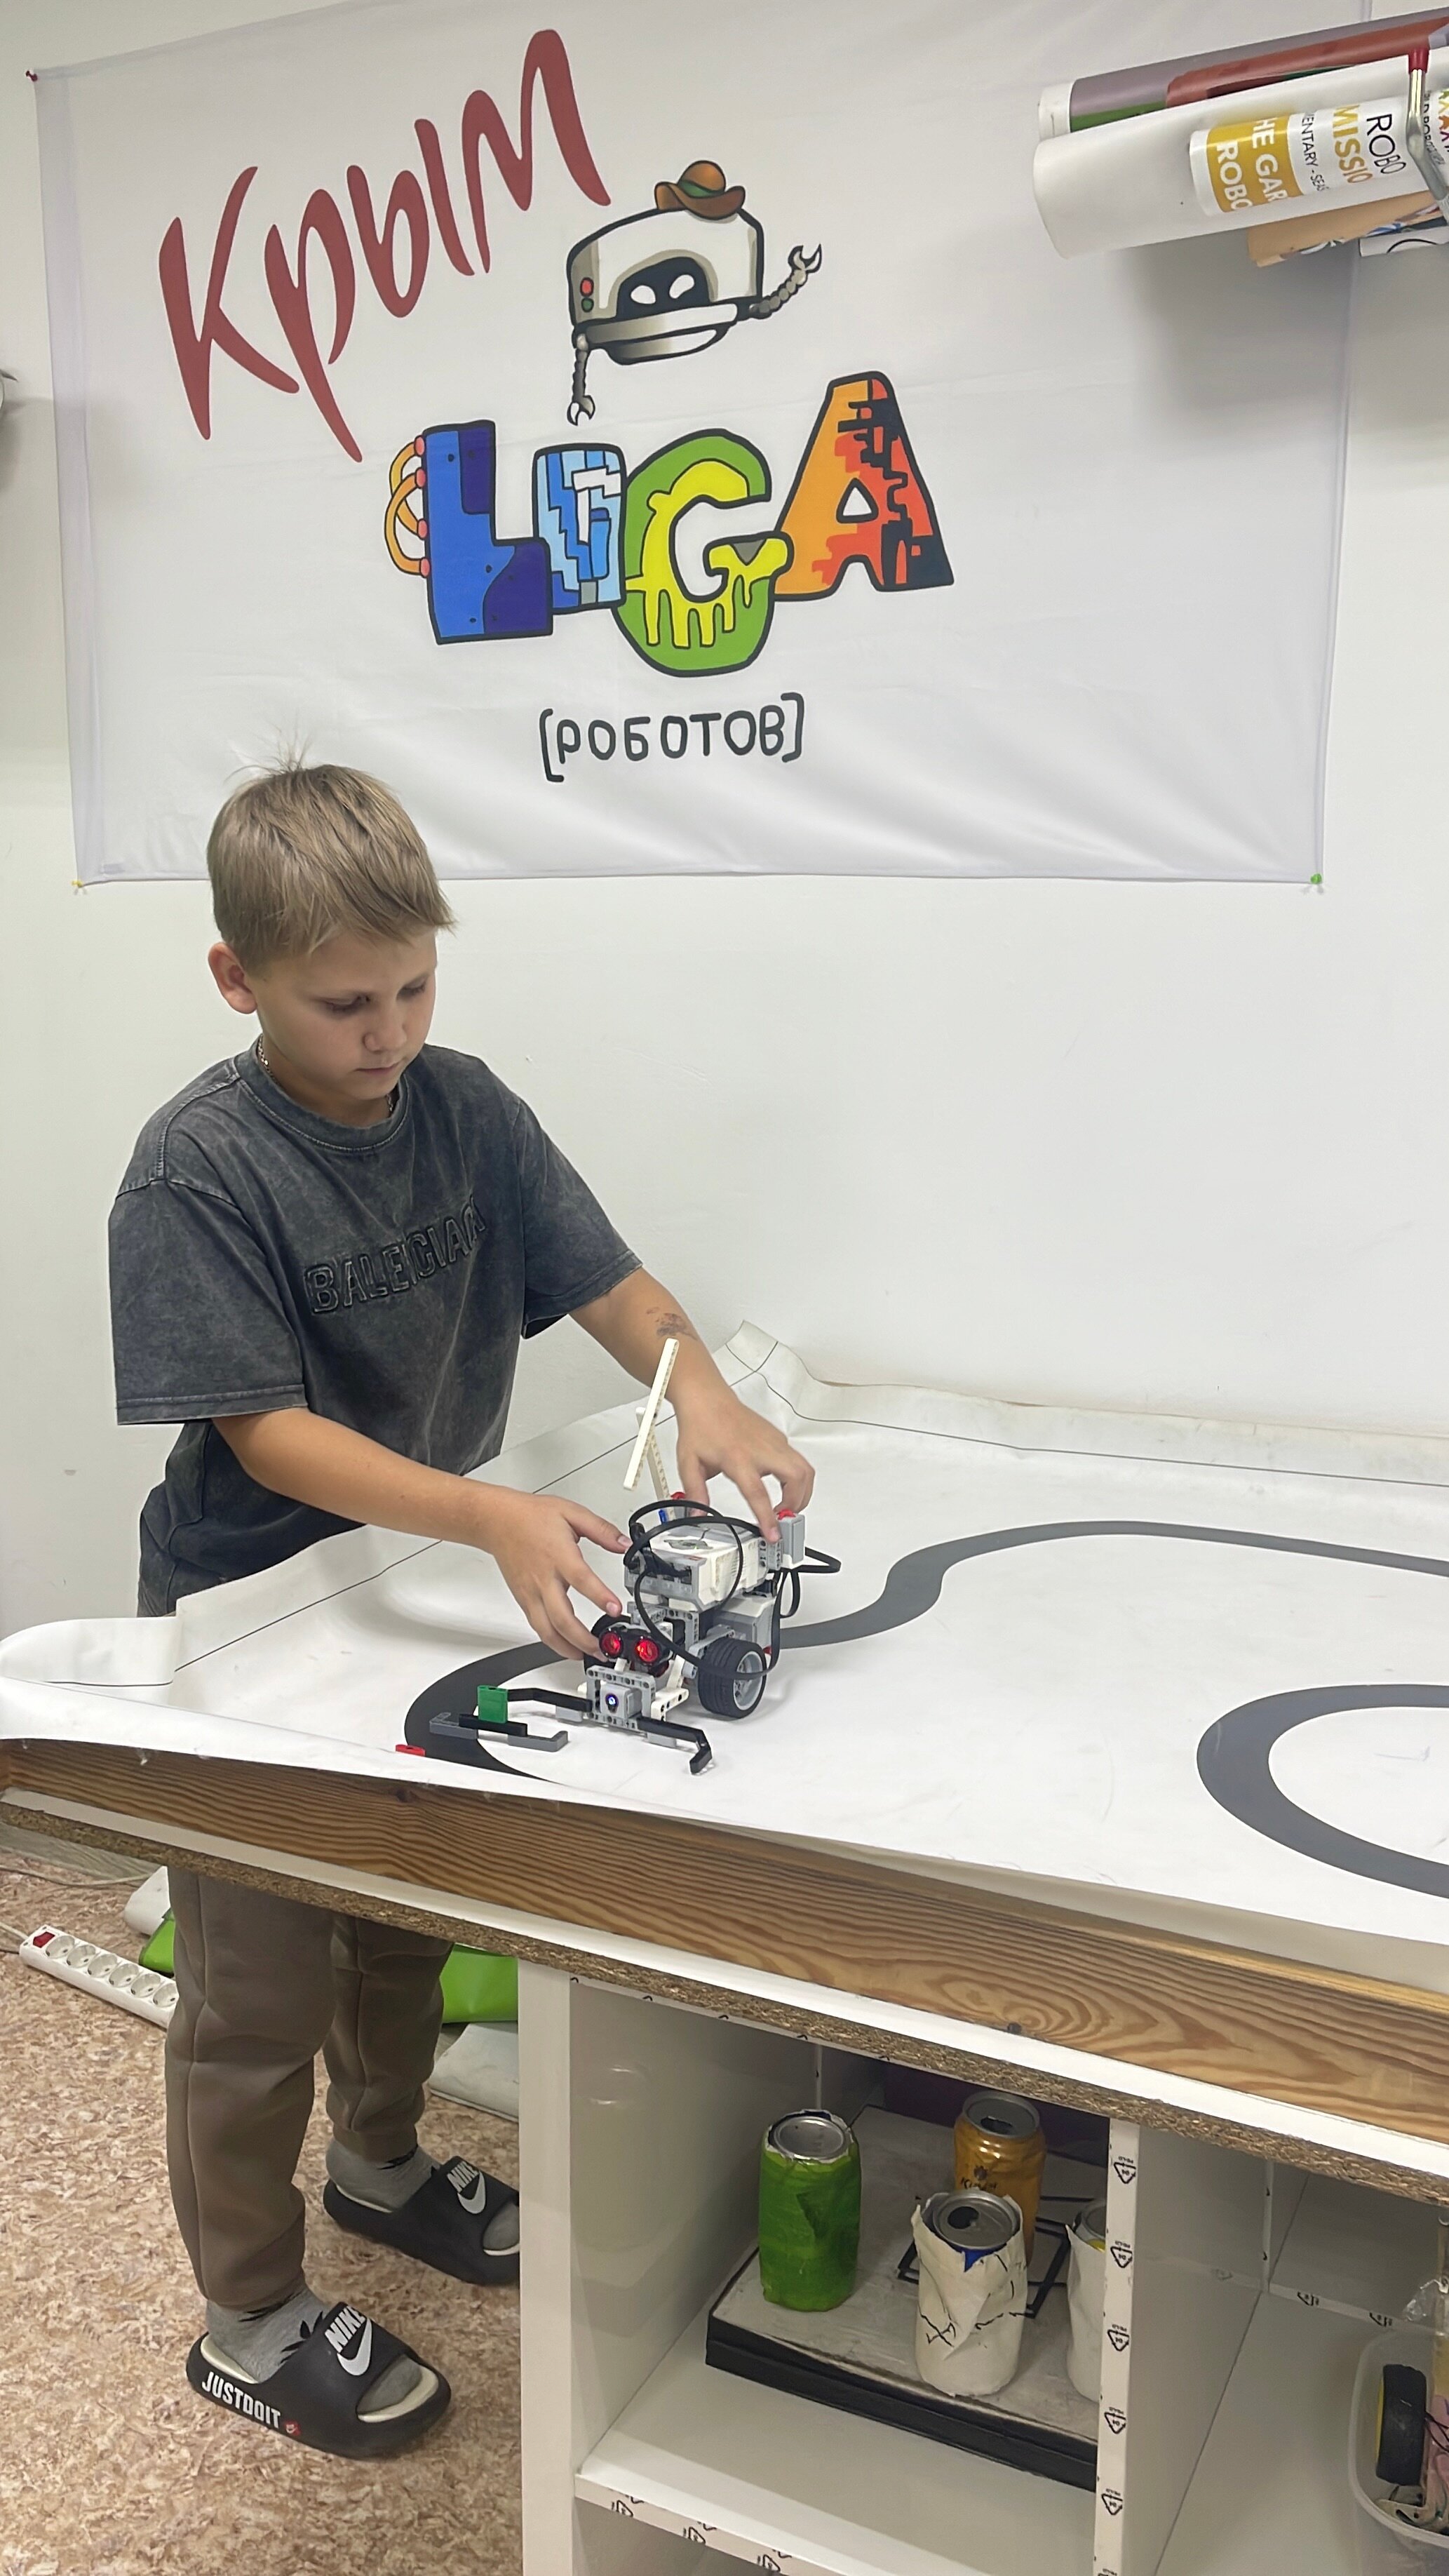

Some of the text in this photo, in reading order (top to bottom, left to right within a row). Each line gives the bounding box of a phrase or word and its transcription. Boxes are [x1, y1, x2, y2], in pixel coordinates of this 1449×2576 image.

[1301, 112, 1319, 167] ENTARY
[1366, 114, 1406, 174] ROBO
[159, 29, 611, 462] Крым
[422, 371, 955, 677] LIGA
[447, 2161, 479, 2193] NIKE
[325, 2305, 366, 2353] NIKE
